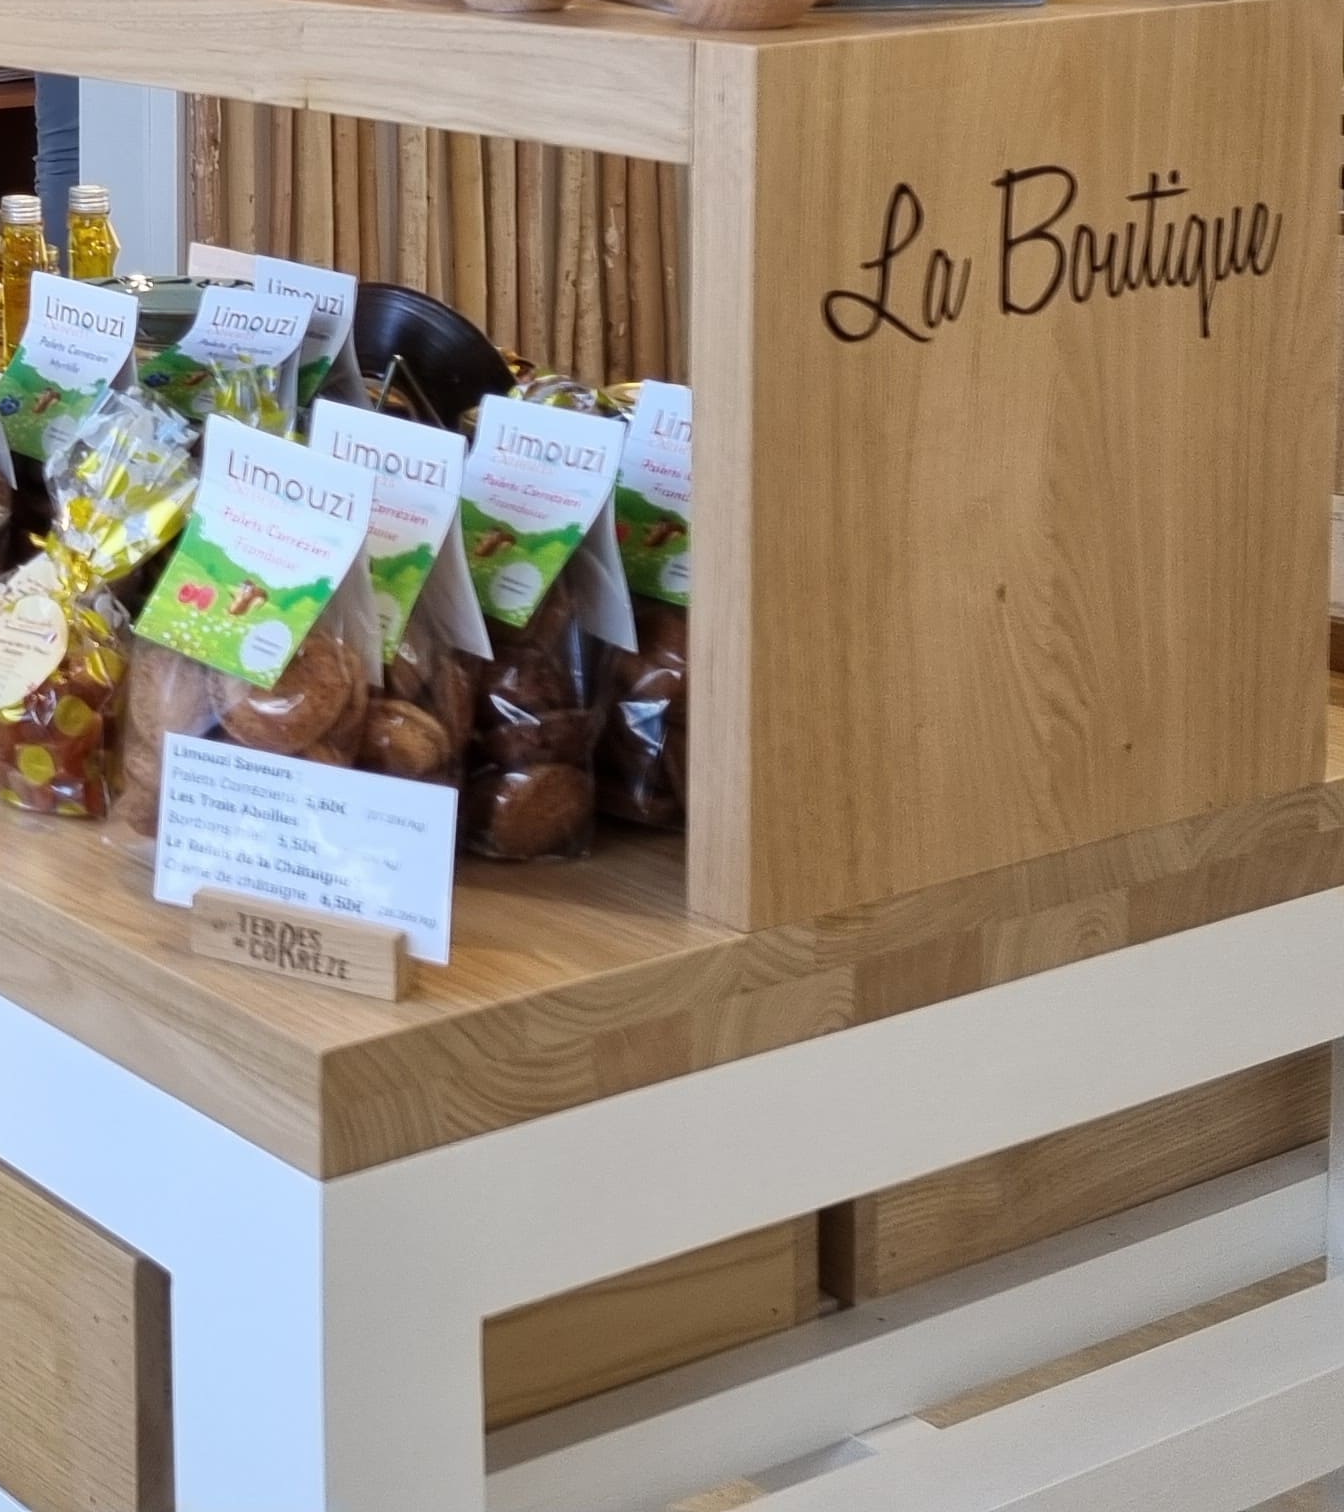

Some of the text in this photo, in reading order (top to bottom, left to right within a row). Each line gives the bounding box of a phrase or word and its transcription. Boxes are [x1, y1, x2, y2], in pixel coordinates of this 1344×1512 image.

[821, 164, 1283, 344] La Boutique
[45, 296, 126, 338] Limouzi
[212, 305, 299, 337] Limouzi
[332, 431, 449, 489] Limouzi
[496, 423, 608, 474] Limouzi
[227, 449, 354, 522] Limouzi
[169, 789, 196, 806] Les
